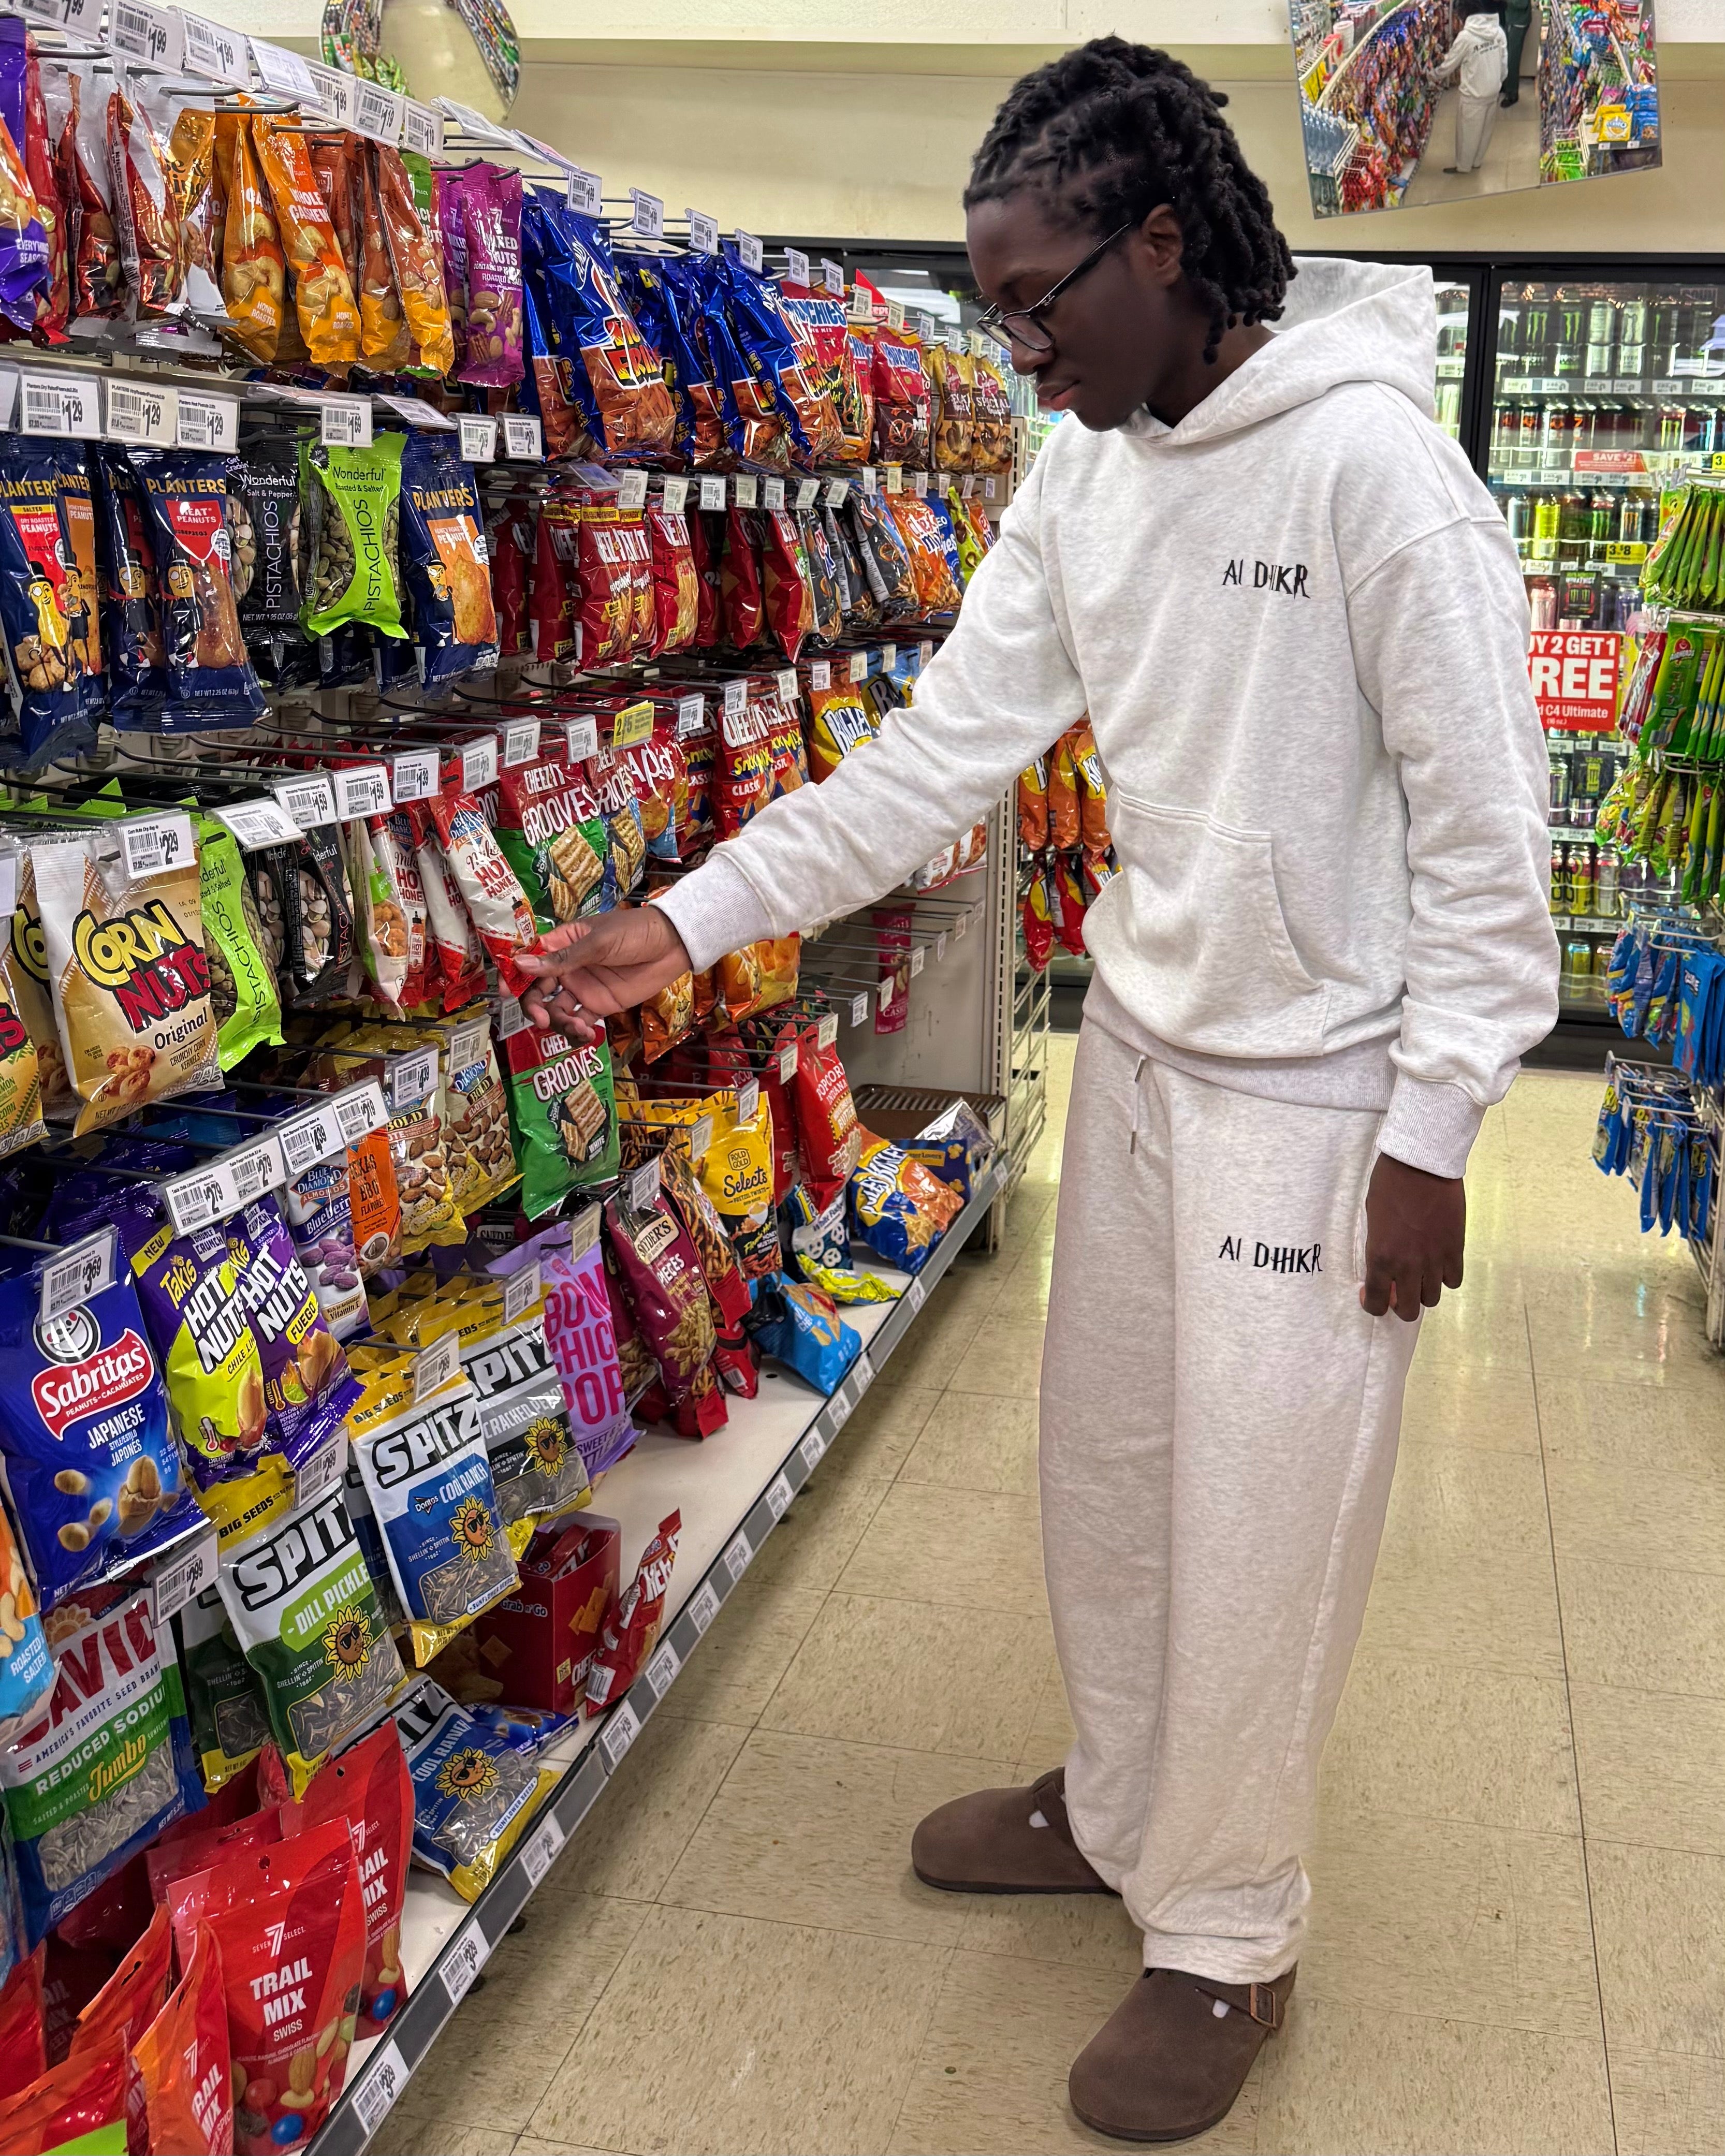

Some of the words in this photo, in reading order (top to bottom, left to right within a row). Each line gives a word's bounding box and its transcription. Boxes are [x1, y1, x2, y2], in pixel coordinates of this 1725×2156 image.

[332, 468, 384, 481] Wonderful
[1593, 453, 1619, 461] SAVE
[148, 478, 226, 494] PLANTERS
[240, 474, 295, 487] Wonderful
[413, 487, 474, 512] PLANTERS
[21, 523, 58, 533] PEANUTS
[266, 501, 280, 609] PISTACHIOS
[355, 500, 381, 611] PISTACHIOS
[1551, 636, 1563, 654] 2
[1566, 637, 1604, 655] GET
[1606, 638, 1615, 656] 1
[1545, 704, 1559, 716] C4
[1562, 705, 1608, 718] Ultimate
[522, 784, 600, 846] GROOVES
[159, 831, 178, 865] $229
[74, 903, 185, 986] CORN
[154, 1013, 208, 1050] Original
[170, 1048, 193, 1066] CRUNCHY
[194, 1039, 206, 1052] CORN
[181, 1052, 200, 1072] KERNELS
[471, 1079, 490, 1101] BOLD
[533, 1046, 605, 1101] GROOVES
[256, 1154, 272, 1187] $279
[298, 1169, 342, 1194] DIAMOND
[308, 1167, 329, 1181] BLUE
[724, 1166, 767, 1197] Selects
[203, 1180, 223, 1215] $279
[143, 1236, 165, 1259] NEW
[196, 1235, 225, 1255] CRUNCH
[82, 1256, 101, 1294] $369
[160, 1258, 198, 1310] Takis
[240, 1243, 282, 1313] HOT
[184, 1269, 226, 1339] HOT
[257, 1257, 308, 1343] NUTS
[196, 1287, 247, 1374] NUTS
[290, 1301, 316, 1340] FUEGO
[227, 1350, 247, 1374] CHILE
[37, 1345, 145, 1418] Sabritas
[88, 1402, 145, 1449] JAPANESE
[111, 1438, 143, 1466] JAPONÉS
[374, 1400, 479, 1489] SPITZ
[439, 1475, 463, 1504] COOL
[464, 1462, 487, 1492] RANCH
[218, 1519, 241, 1539] BIG
[243, 1496, 274, 1525] SEEDS
[294, 1604, 326, 1635] DILL
[325, 1565, 371, 1615] PICKLE
[10, 1638, 41, 1675] ROASTED
[24, 1653, 48, 1684] SALTED
[36, 1728, 75, 1764] AMERICA'S
[75, 1695, 113, 1732] FAVORITE
[116, 1679, 138, 1700] SEED
[35, 1731, 110, 1797] REDUCED
[114, 1684, 167, 1733] SODIU
[414, 1758, 438, 1782] COOL
[440, 1719, 472, 1758] RANCH
[89, 1734, 147, 1802] Jumbo
[33, 1805, 57, 1825] SALTED
[65, 1783, 90, 1803] ROASTED
[495, 1800, 522, 1834] SUNFLOWER
[367, 1904, 387, 1926] SWISS
[252, 1940, 271, 1954] SEVEN
[251, 1957, 313, 2001] TRAIL
[264, 1987, 306, 2026] MIX
[273, 2019, 303, 2042] SWISS
